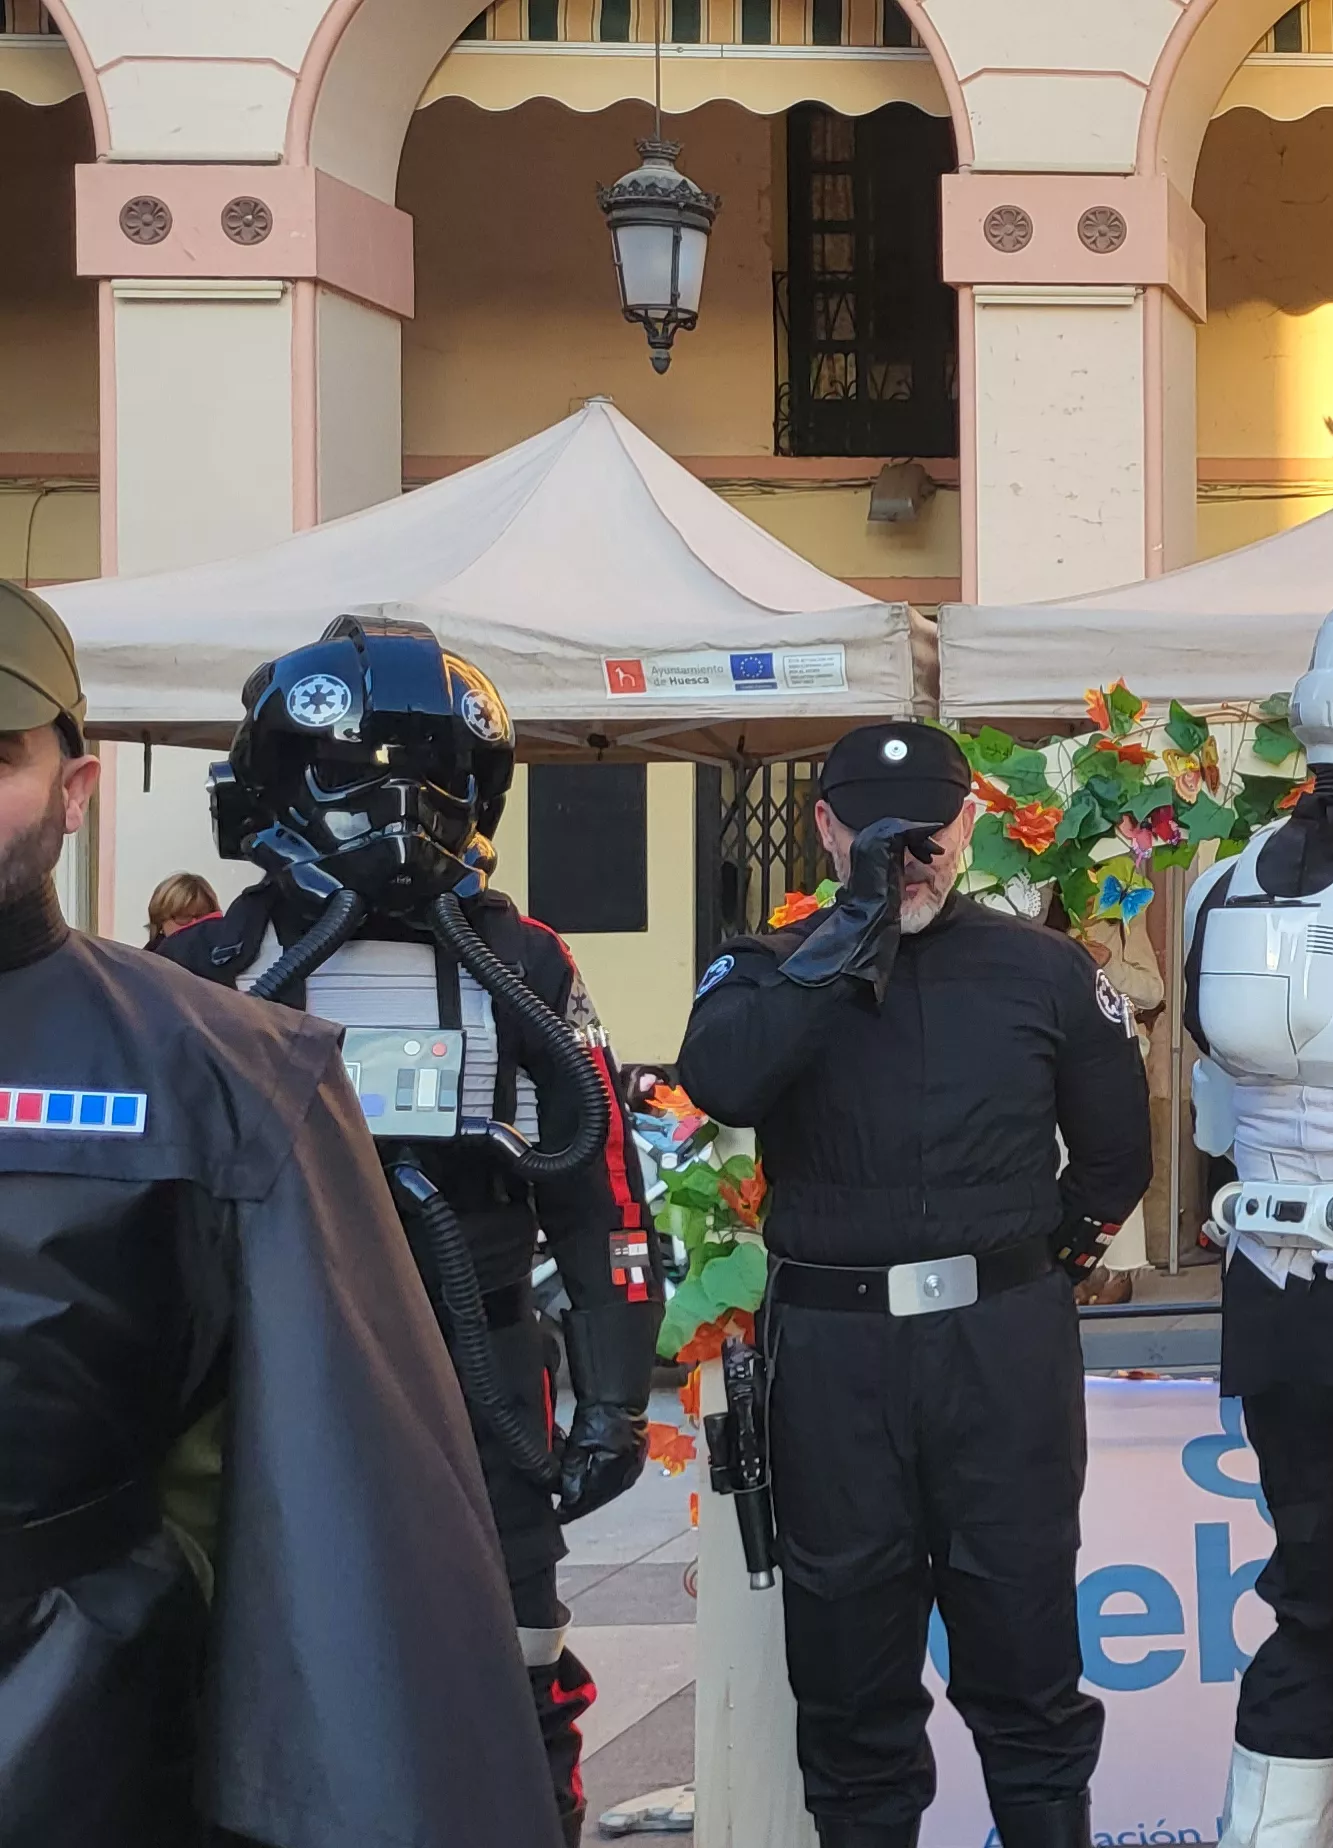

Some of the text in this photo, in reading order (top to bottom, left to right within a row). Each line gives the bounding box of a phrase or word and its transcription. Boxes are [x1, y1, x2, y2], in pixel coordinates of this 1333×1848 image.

[651, 664, 724, 677] Ayuntamiento
[653, 676, 710, 687] de Huesca
